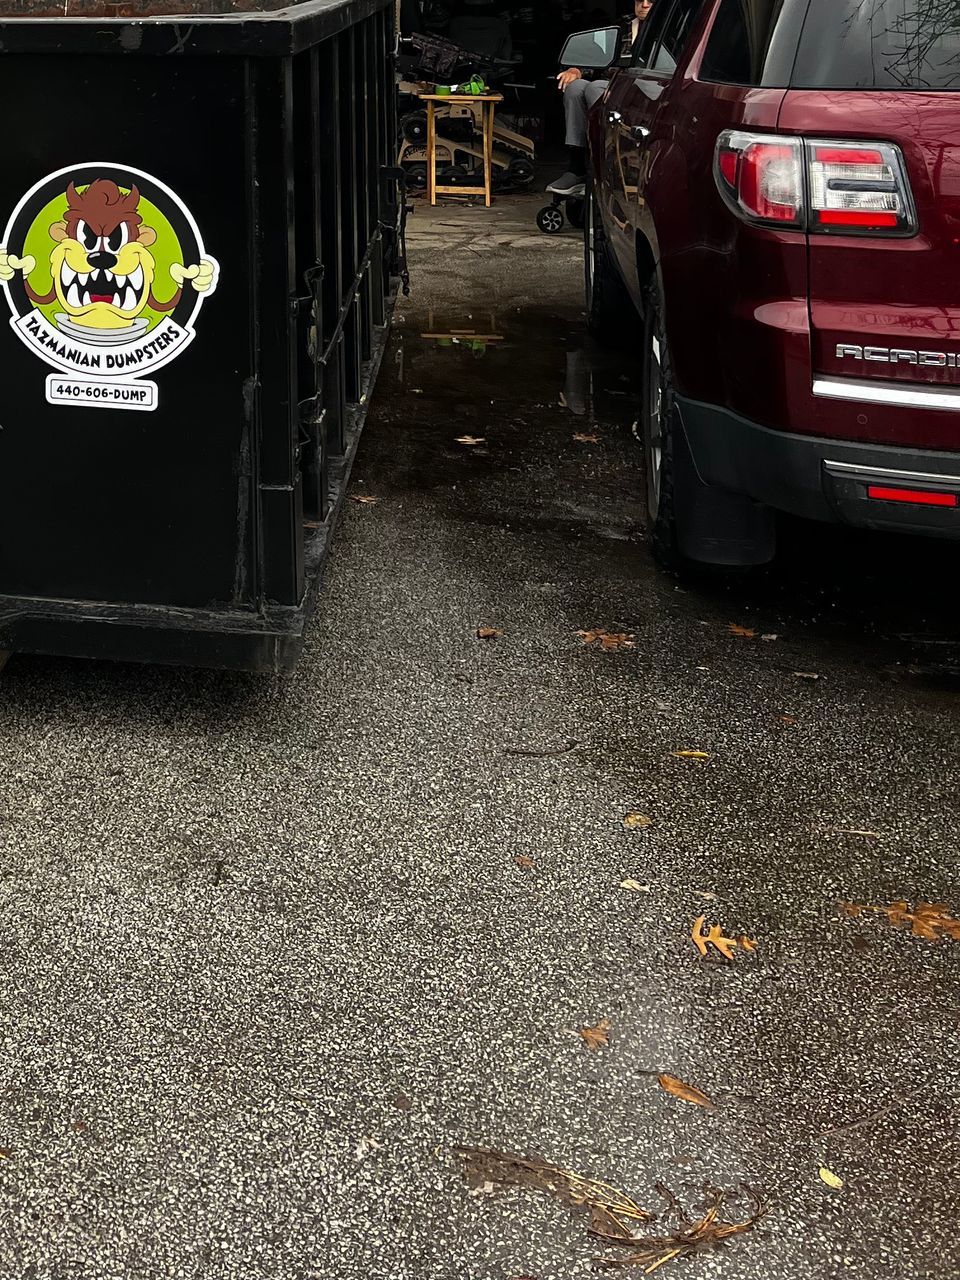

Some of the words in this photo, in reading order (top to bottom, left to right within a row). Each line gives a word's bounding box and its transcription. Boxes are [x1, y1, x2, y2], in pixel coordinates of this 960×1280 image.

[26, 317, 100, 368] TAZMANIAN
[106, 325, 180, 368] DUMPSTERS
[836, 344, 960, 367] ACADI
[57, 385, 146, 401] 440-606-DUMP
